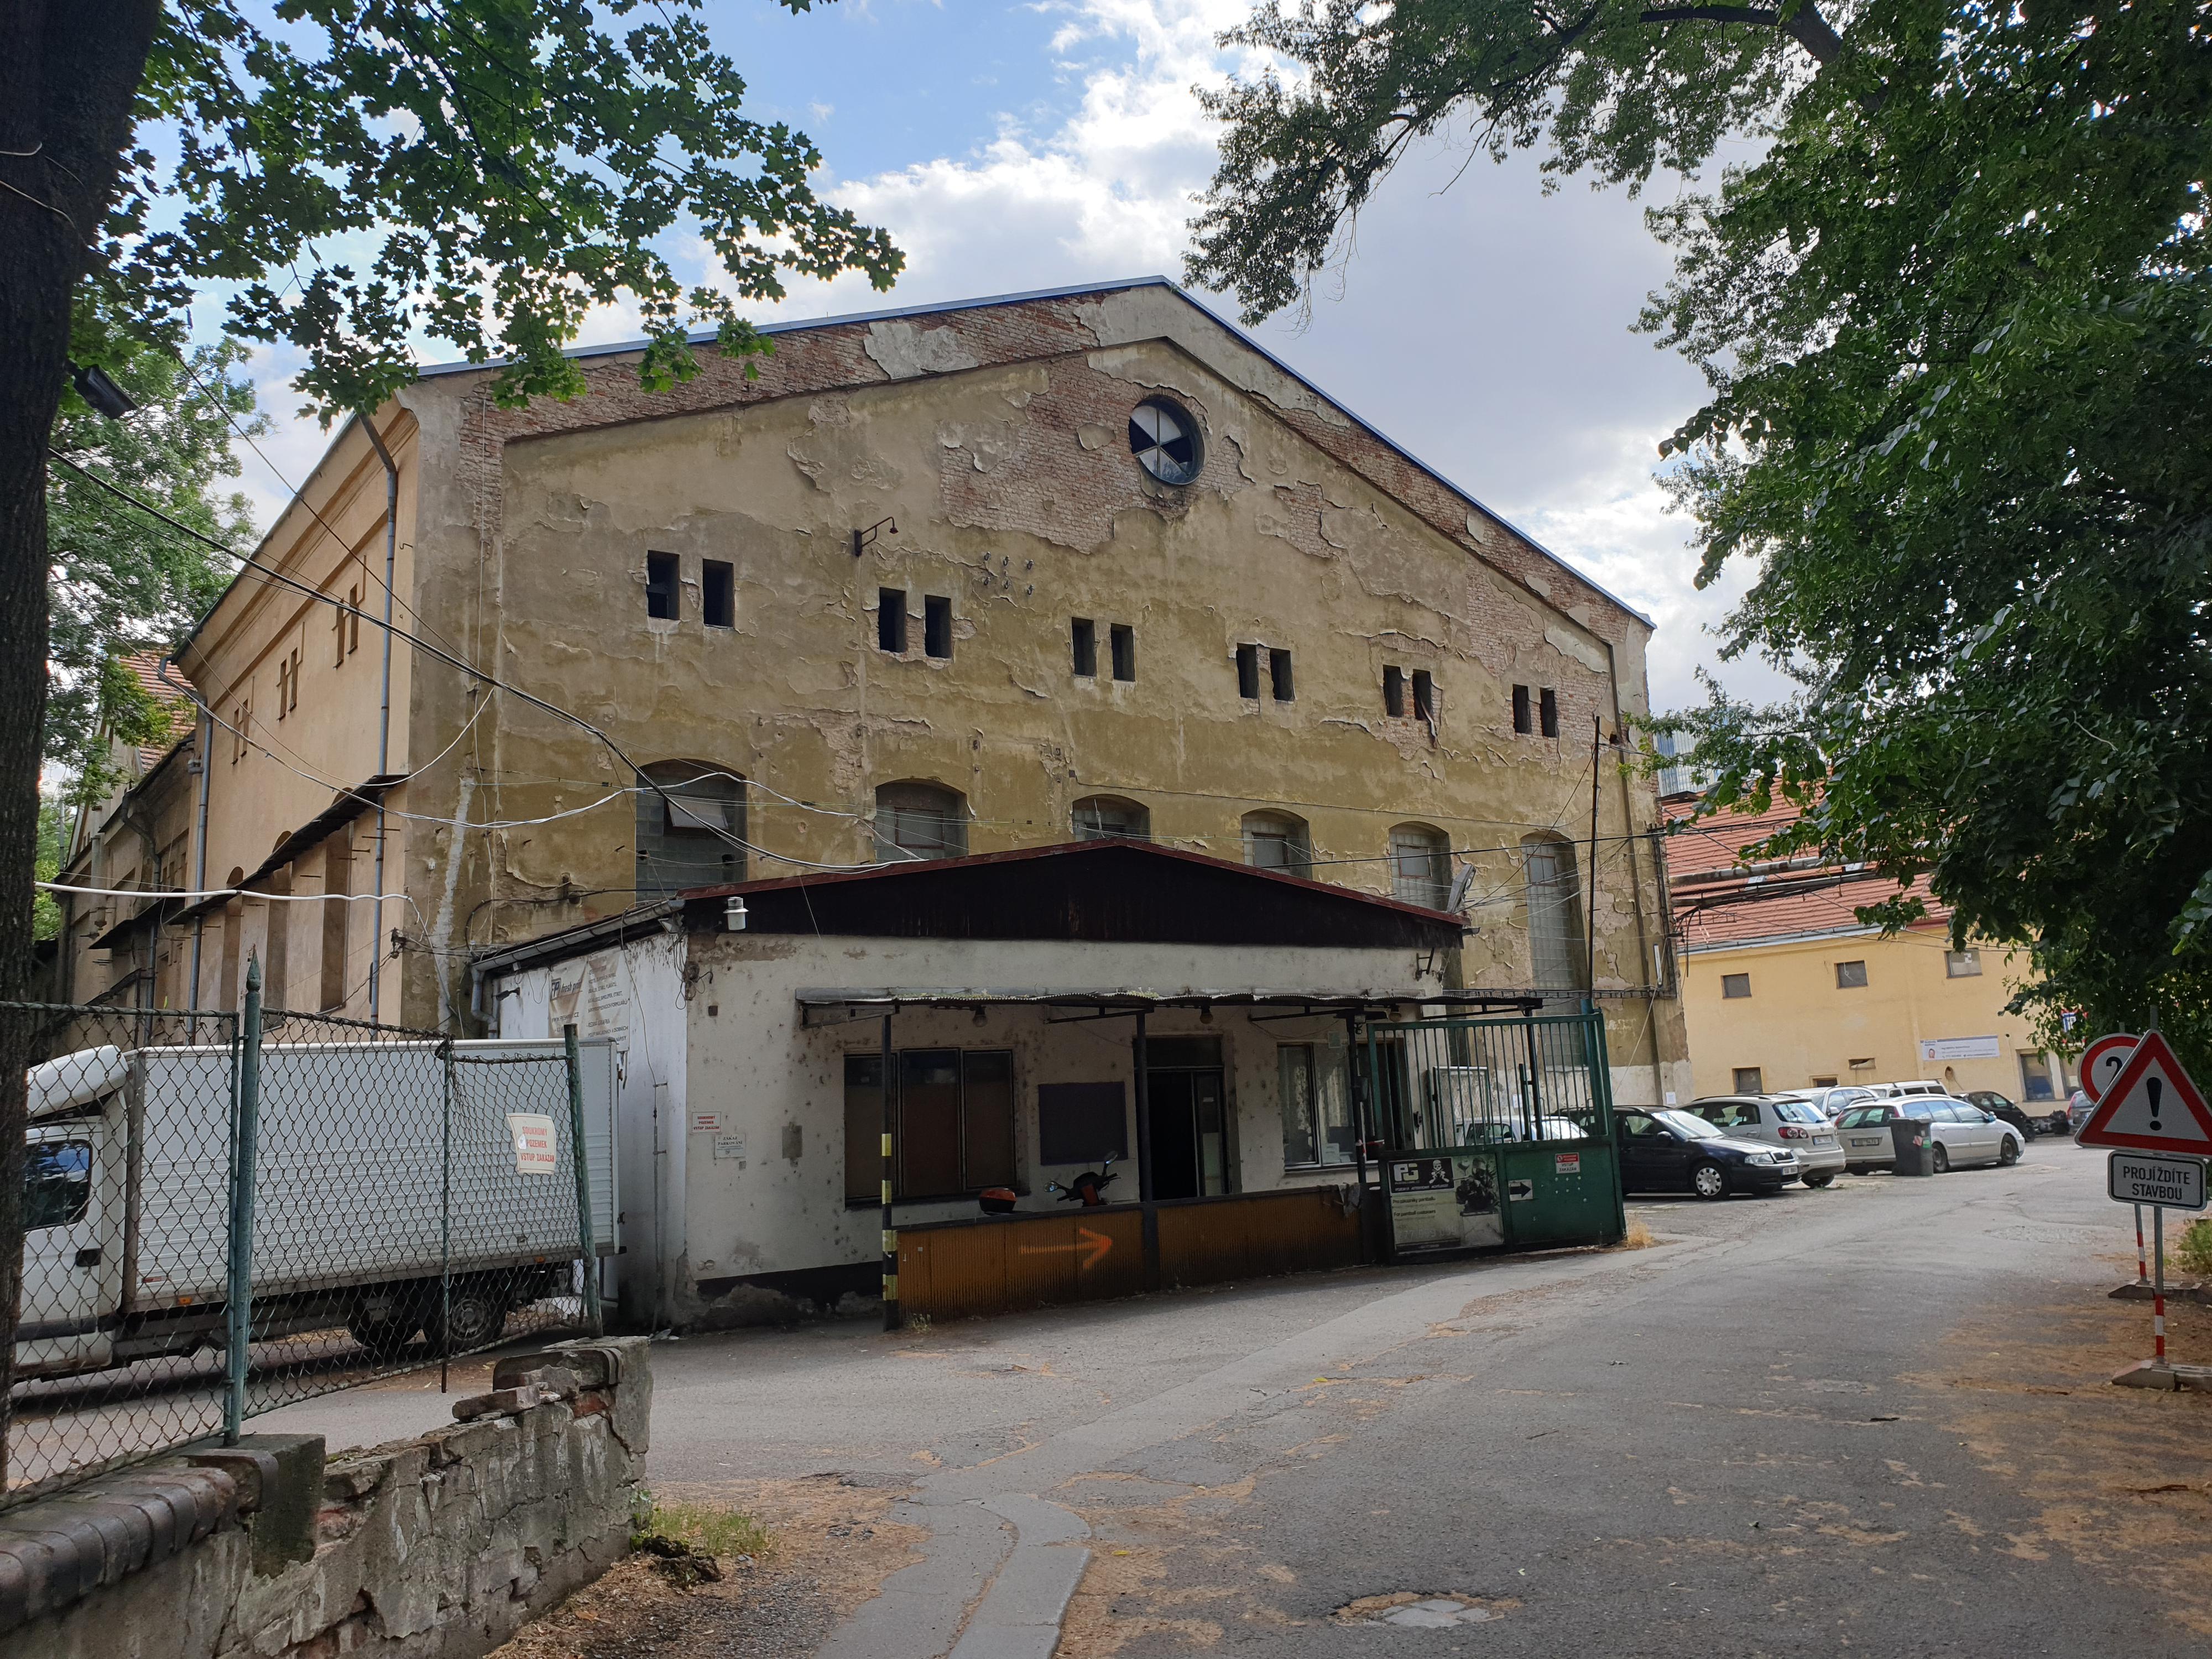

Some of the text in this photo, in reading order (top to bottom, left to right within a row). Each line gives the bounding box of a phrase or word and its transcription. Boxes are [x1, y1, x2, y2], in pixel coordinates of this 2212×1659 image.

[520, 1152, 555, 1162] VSTUP ZAKÁZÁN
[2123, 1166, 2190, 1185] PROJÍŽDÍTE
[2132, 1183, 2182, 1201] STAVBOU
